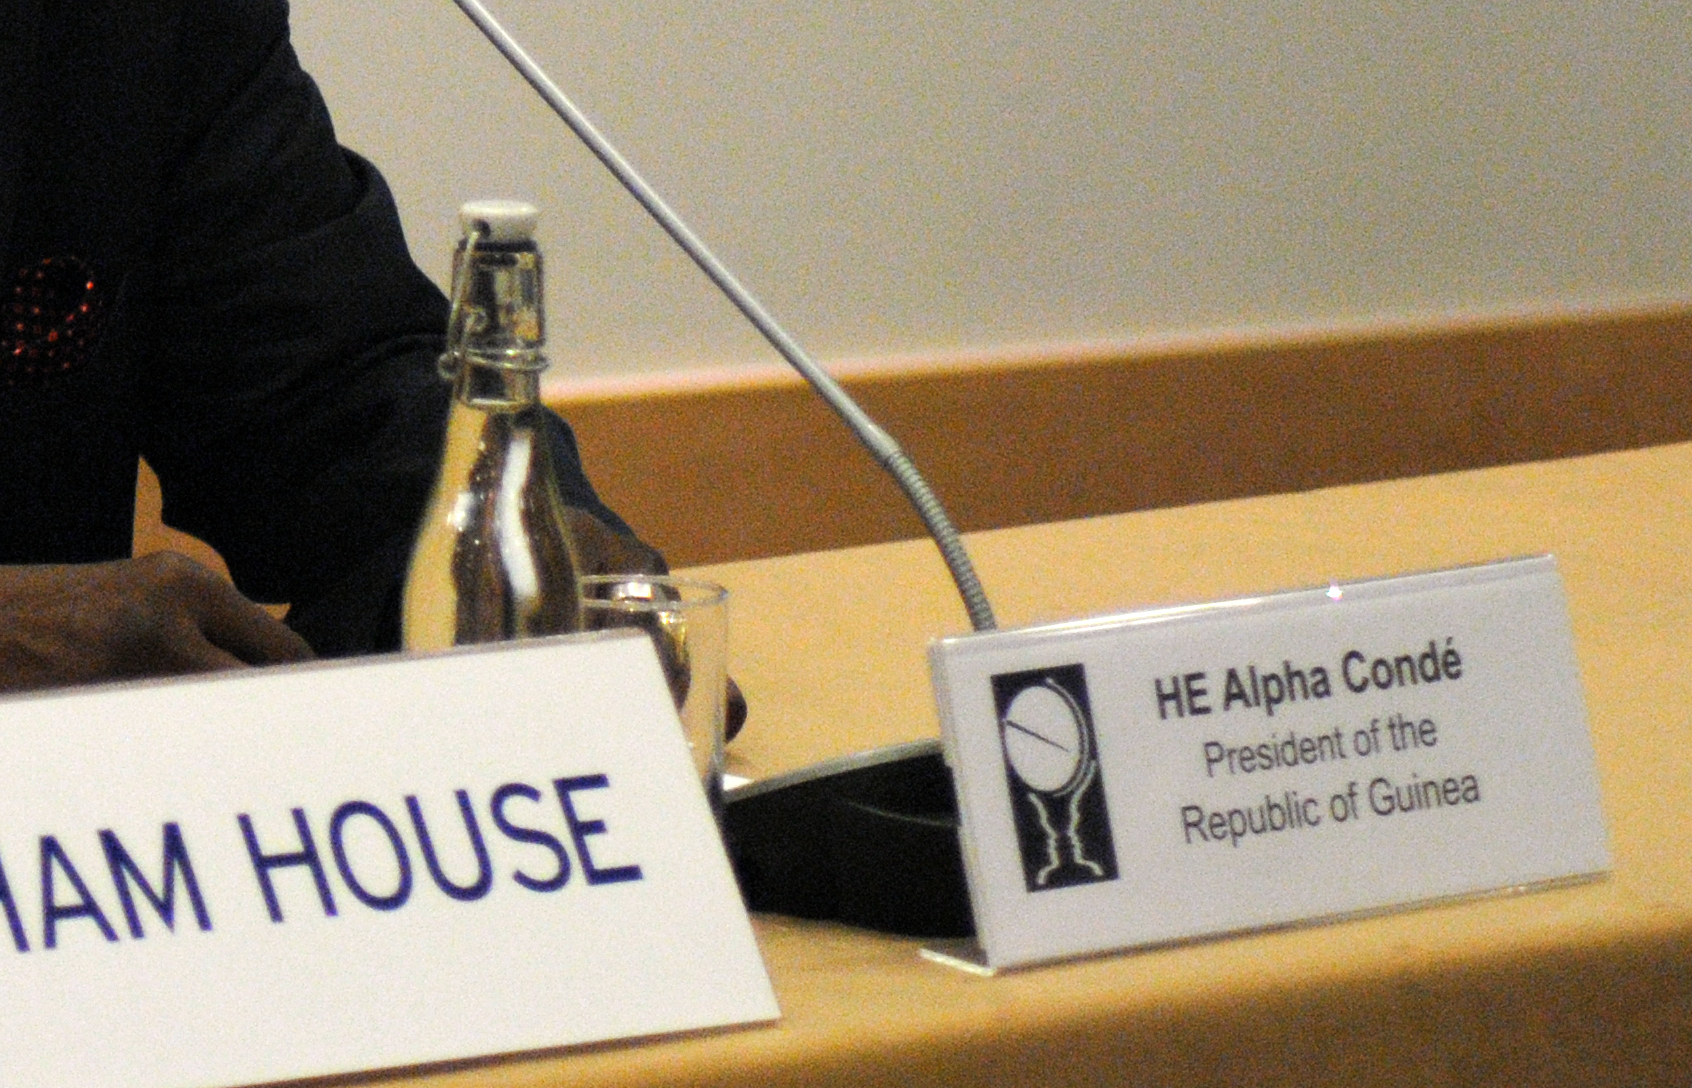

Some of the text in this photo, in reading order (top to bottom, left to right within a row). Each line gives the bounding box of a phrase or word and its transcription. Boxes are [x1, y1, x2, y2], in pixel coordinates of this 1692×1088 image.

[1153, 636, 1465, 721] HE Alpha Condé
[1202, 712, 1439, 778] President of the
[235, 772, 646, 925] HOUSE
[1179, 772, 1481, 848] Republic of Guinea
